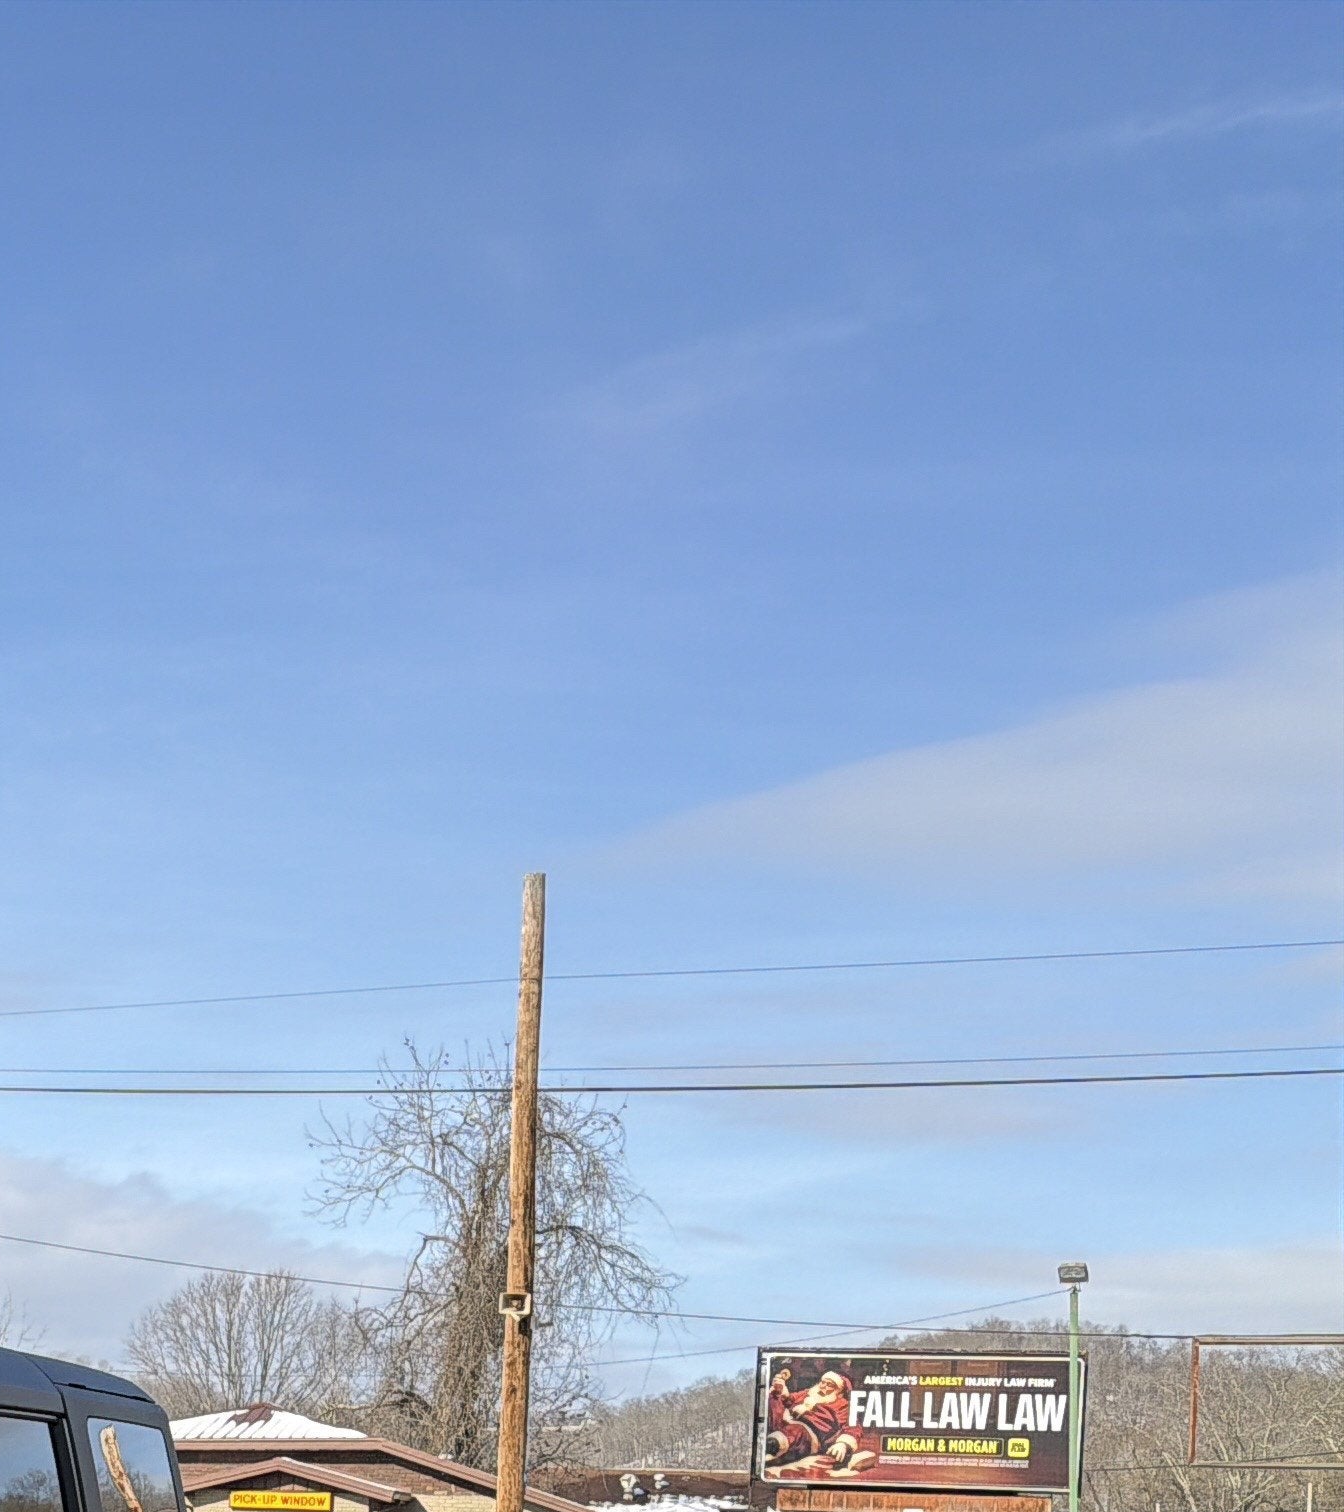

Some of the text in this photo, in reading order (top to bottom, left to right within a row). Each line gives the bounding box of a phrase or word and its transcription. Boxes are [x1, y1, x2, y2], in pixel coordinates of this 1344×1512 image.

[863, 1375, 918, 1386] AMERICA'S
[918, 1376, 963, 1387] LARGEST
[964, 1377, 1002, 1387] INJURY
[1003, 1377, 1027, 1388] LAW
[848, 1390, 1068, 1433] FALL LAW LAW
[886, 1438, 935, 1452] MORGAN
[937, 1439, 947, 1453] &
[948, 1439, 998, 1455] MORGAN
[233, 1493, 327, 1507] PICK-UP WINDOW
